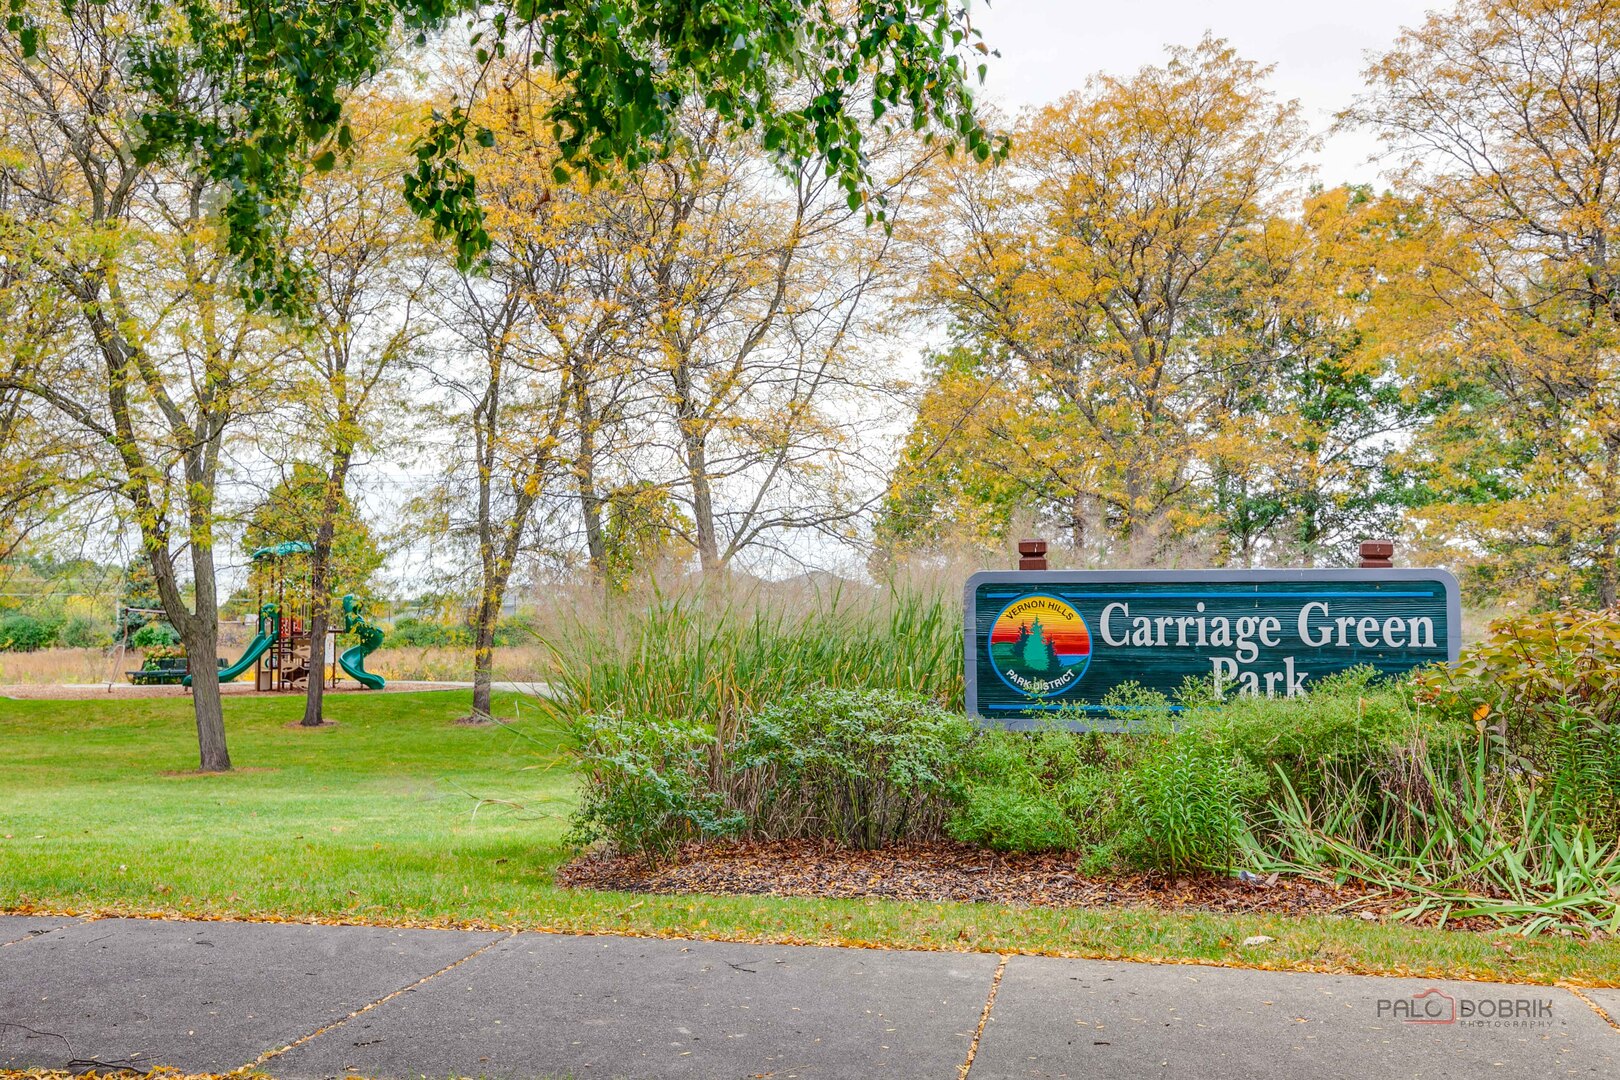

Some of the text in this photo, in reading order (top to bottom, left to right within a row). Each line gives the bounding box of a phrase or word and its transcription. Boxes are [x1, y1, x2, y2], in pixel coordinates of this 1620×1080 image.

[1005, 600, 1074, 621] VERNON HILLS
[1100, 601, 1437, 663] Carriage Green
[1006, 668, 1075, 691] PARK DISTRICT
[1209, 656, 1311, 702] Park
